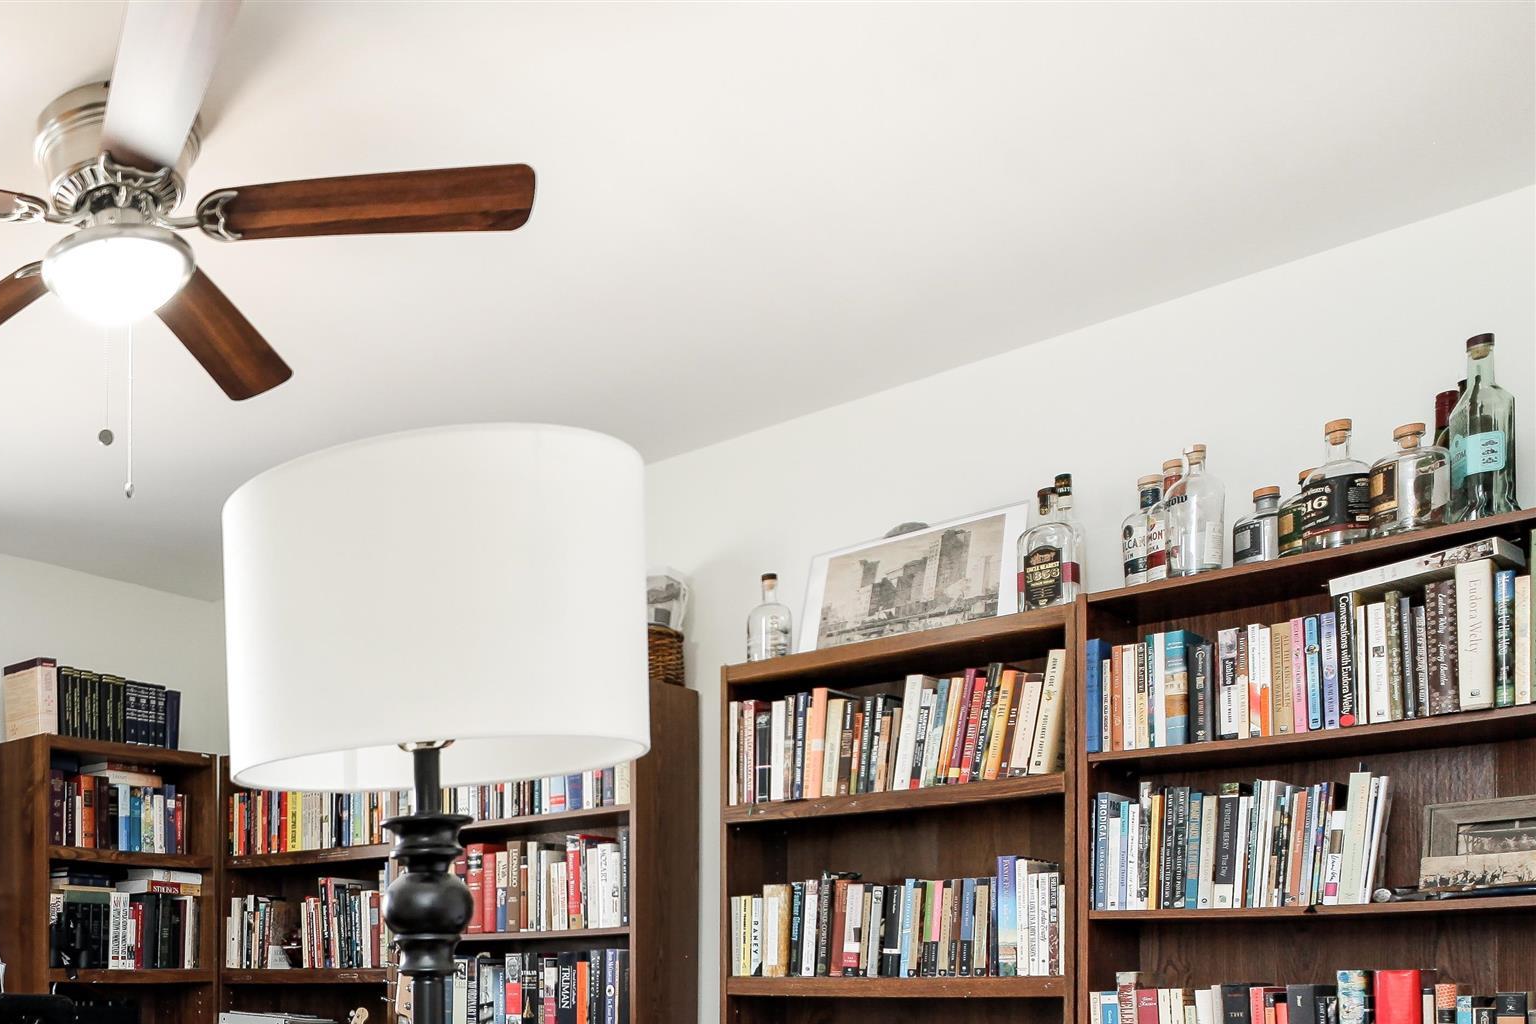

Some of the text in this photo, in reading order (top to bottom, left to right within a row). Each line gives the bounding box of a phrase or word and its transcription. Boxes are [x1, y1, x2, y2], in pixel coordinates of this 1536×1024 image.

[1465, 580, 1482, 653] Eudora Welty
[1339, 596, 1353, 715] Conversations with Eudora Welty
[1436, 616, 1448, 686] Welty Losing Battles
[1050, 657, 1059, 670] JOHN
[1225, 660, 1233, 685] Jubilee
[984, 689, 994, 708] WHERE
[968, 704, 981, 720] LOVER
[997, 703, 1007, 718] TALL
[966, 723, 977, 740] HARRY
[979, 720, 988, 734] DEVIL
[1039, 714, 1049, 740] POTLIKKER
[976, 735, 985, 750] DON'T
[1036, 740, 1046, 758] PAPERS
[975, 751, 983, 763] STAY
[1098, 799, 1108, 842] PRODIGAL
[1219, 802, 1232, 877] WENDELL BERRY This Day
[600, 849, 608, 882] MOZART
[1002, 859, 1011, 881] FANNIE
[822, 884, 830, 894] THE
[1049, 876, 1057, 907] SHELBY FOOTE
[793, 891, 801, 916] Faulkner
[1029, 901, 1037, 914] LOVE
[1039, 907, 1048, 924] Jordan
[792, 916, 801, 941] Glossary
[1029, 925, 1037, 936] DRY
[1029, 937, 1037, 957] SEASON
[467, 980, 477, 989] NO
[561, 966, 571, 1009] TRUMAN
[467, 989, 477, 1016] ORDINARY
